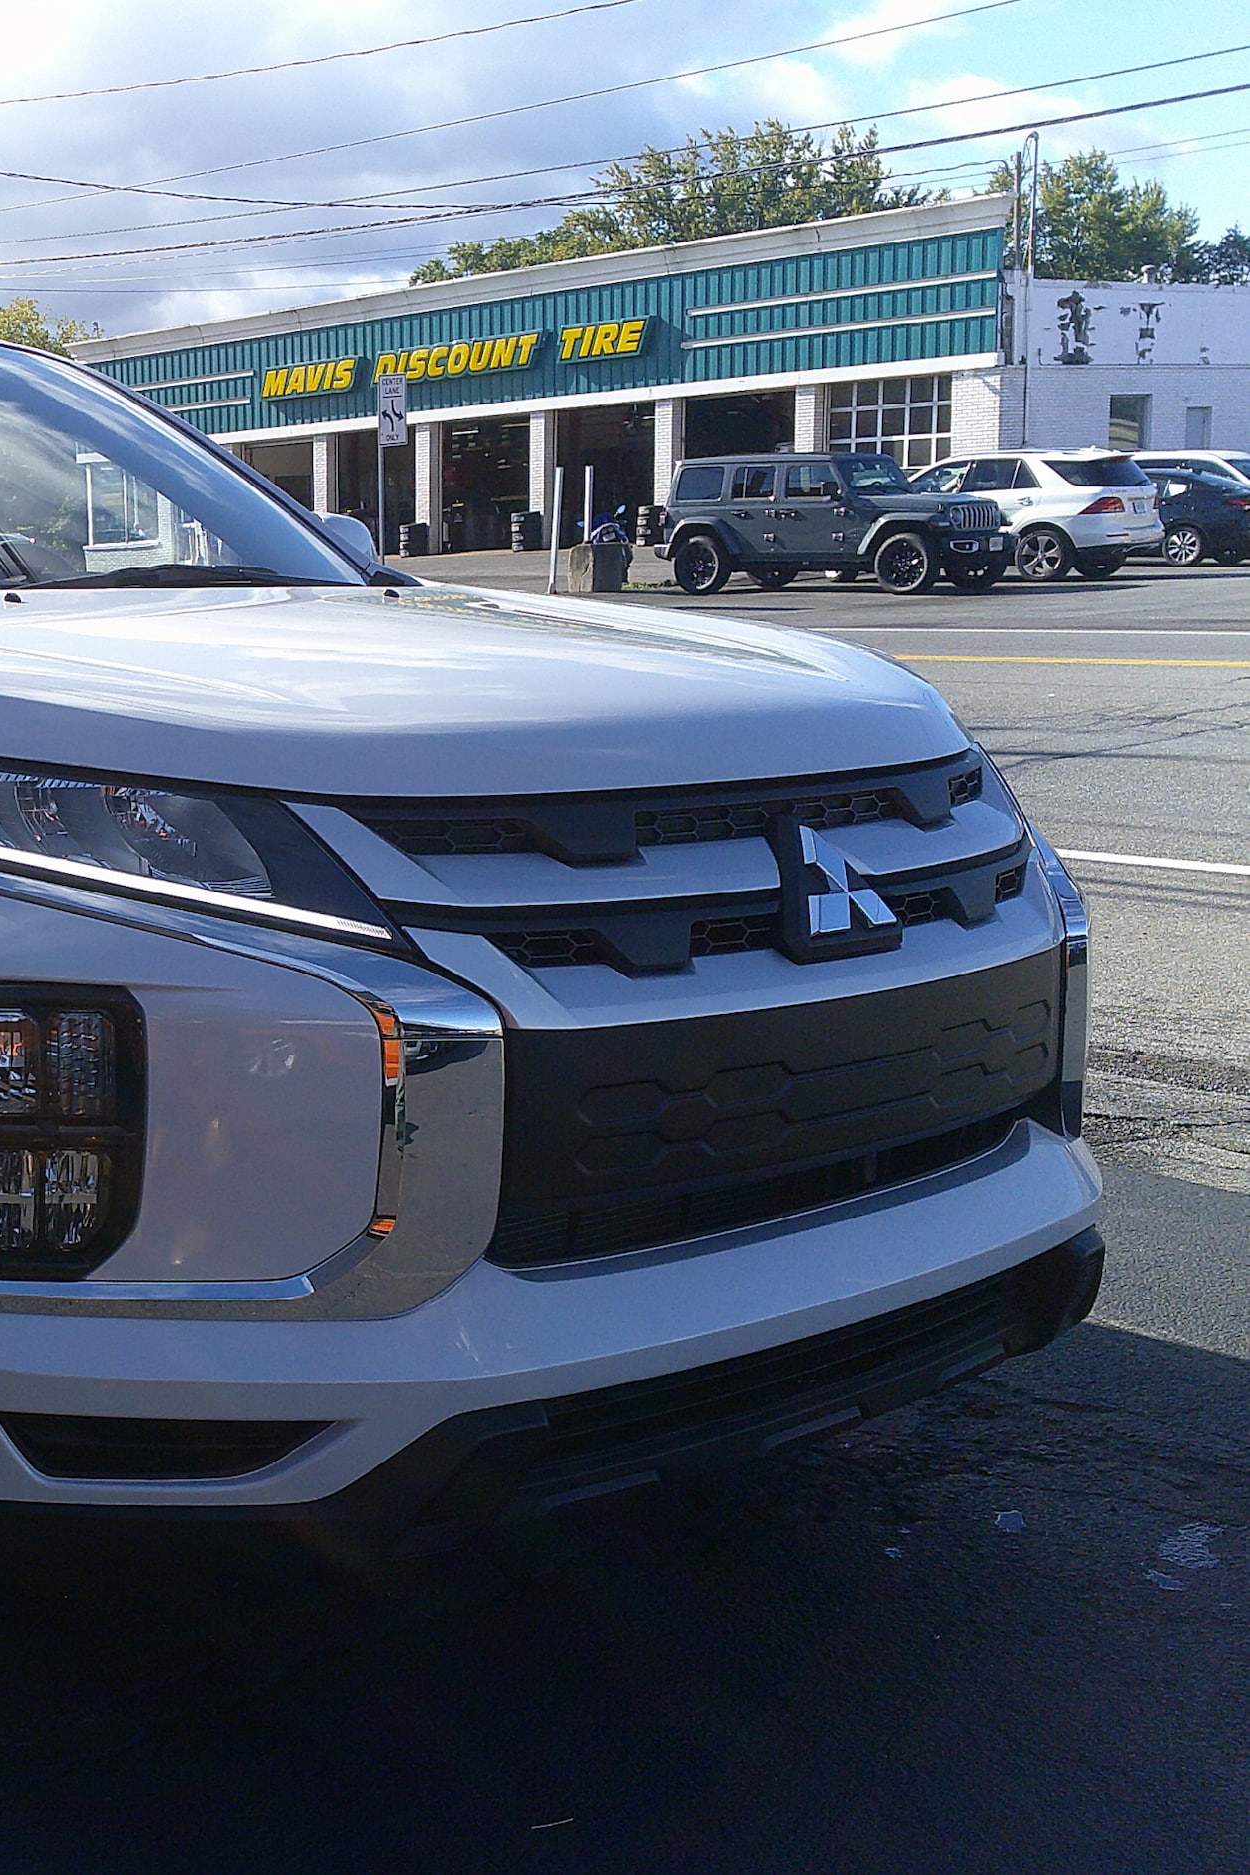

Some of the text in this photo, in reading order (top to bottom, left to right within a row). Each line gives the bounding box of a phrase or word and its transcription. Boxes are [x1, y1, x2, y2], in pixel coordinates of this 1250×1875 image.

[262, 320, 645, 398] MAVIS DISCOUNT TIRE
[381, 377, 403, 386] CENTER
[384, 386, 400, 395] LANE
[385, 433, 400, 442] ONLY
